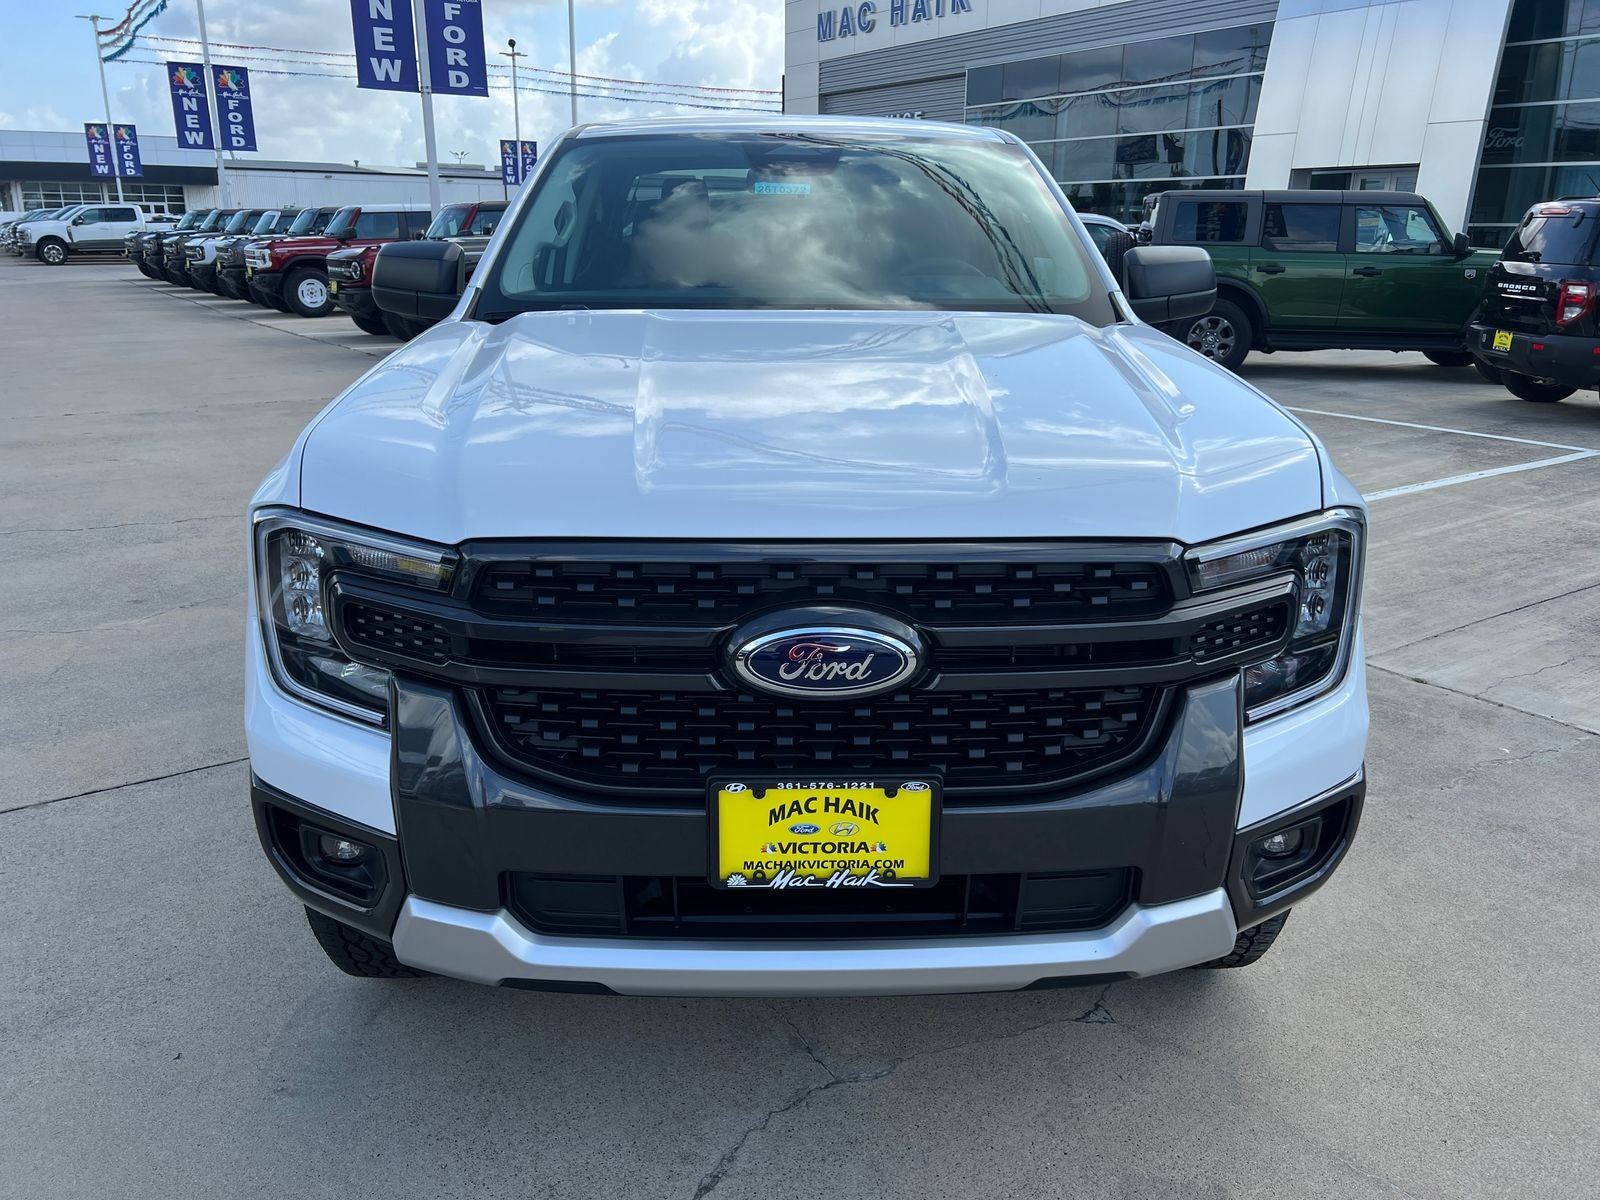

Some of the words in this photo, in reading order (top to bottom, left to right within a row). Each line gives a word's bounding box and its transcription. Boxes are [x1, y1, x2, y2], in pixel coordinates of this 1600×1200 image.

[817, 1, 875, 42] MAC
[368, 0, 402, 83] NEW
[443, 2, 470, 88] FORD
[182, 97, 204, 145] NEW
[227, 99, 246, 147] FORD
[94, 143, 109, 174] NEW
[123, 145, 136, 175] FORD
[505, 157, 516, 184] NEW
[525, 158, 533, 171] FO
[1497, 282, 1537, 291] BRONCO
[779, 642, 874, 681] Ford
[777, 781, 875, 790] 361-576-1221
[768, 796, 818, 827] MAC
[823, 796, 880, 826] HAIK
[777, 841, 870, 855] VICTORIA
[743, 859, 905, 871] MACHAIKVICTORIA.COM
[769, 868, 819, 889] Mac
[825, 868, 881, 889] Haik
